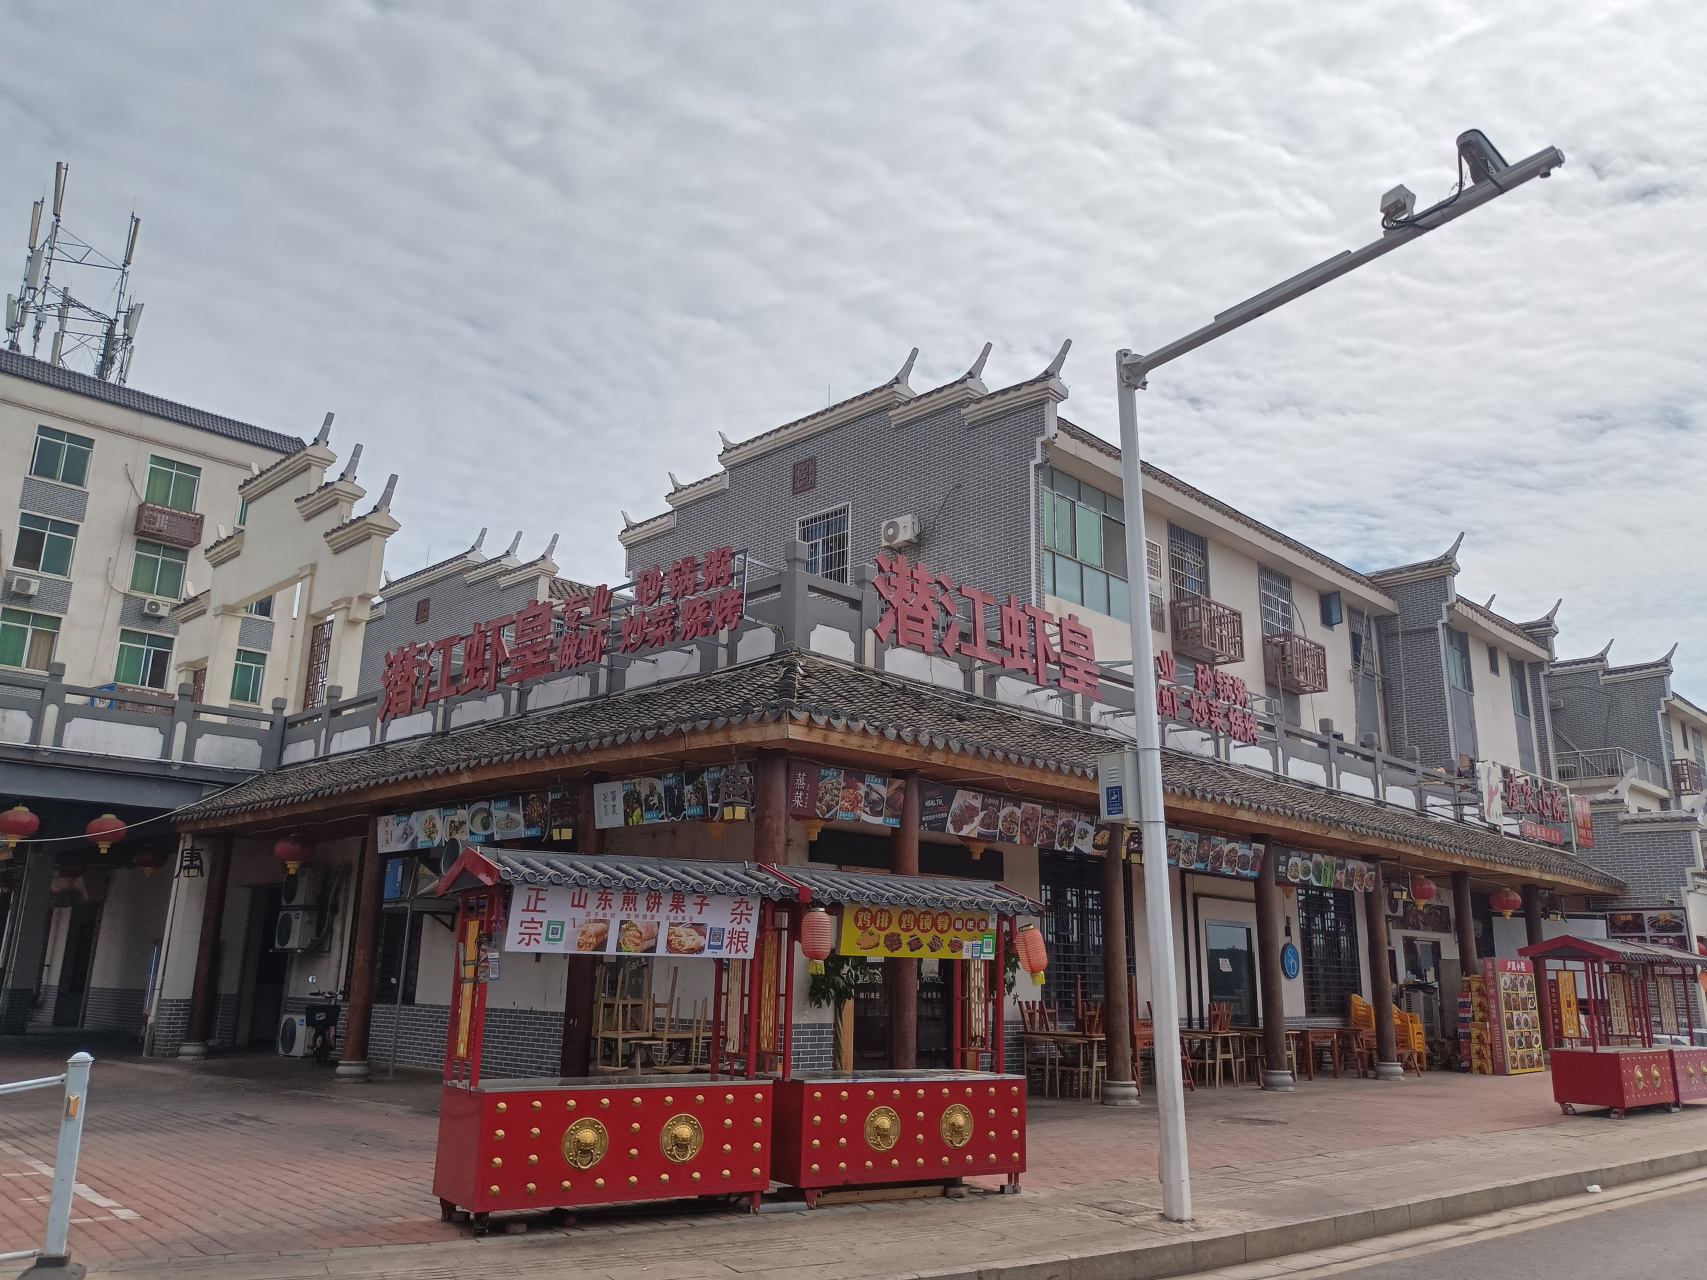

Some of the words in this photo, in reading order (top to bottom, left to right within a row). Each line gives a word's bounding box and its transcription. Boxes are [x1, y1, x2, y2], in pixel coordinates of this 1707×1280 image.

[561, 584, 613, 629] 专业
[636, 545, 733, 606] 砂锅粥
[557, 627, 611, 672] 做虾
[872, 552, 1103, 700] 潜江虾皇
[378, 599, 556, 722] 潜江虾皇
[791, 772, 807, 808] 蒸菜
[517, 887, 548, 947] 正宗
[570, 887, 711, 915] 山东煎饼果子
[725, 897, 751, 955] 杂粮
[856, 910, 890, 929] 鸡排
[901, 911, 950, 931] 鸡锁骨
